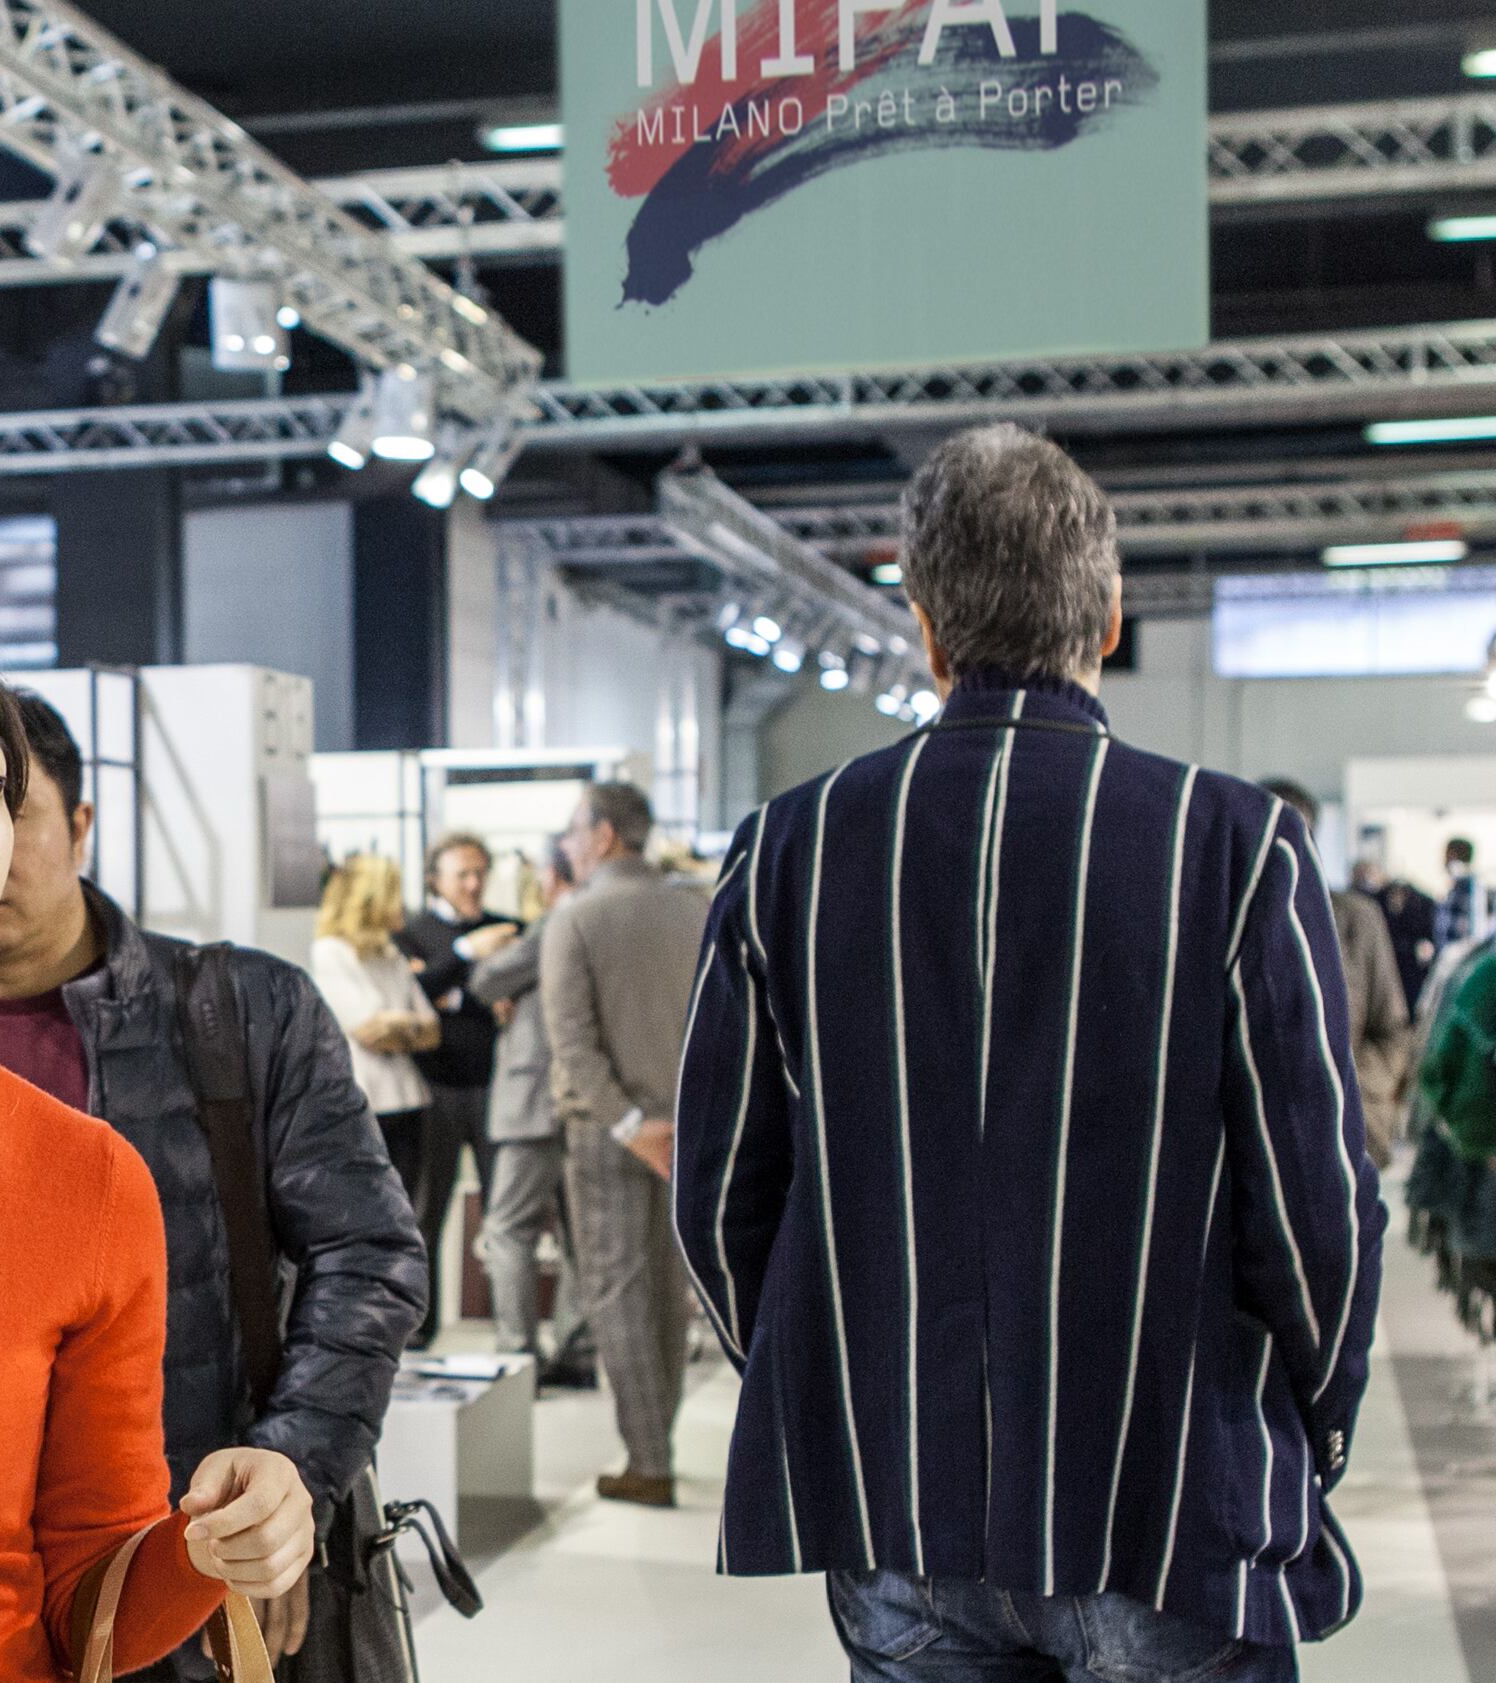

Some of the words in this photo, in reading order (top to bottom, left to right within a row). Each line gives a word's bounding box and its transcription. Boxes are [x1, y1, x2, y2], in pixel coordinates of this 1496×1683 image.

[636, 96, 803, 147] MILANO
[826, 87, 916, 133] Prêt
[935, 85, 955, 124] à
[979, 73, 1123, 121] Porter
